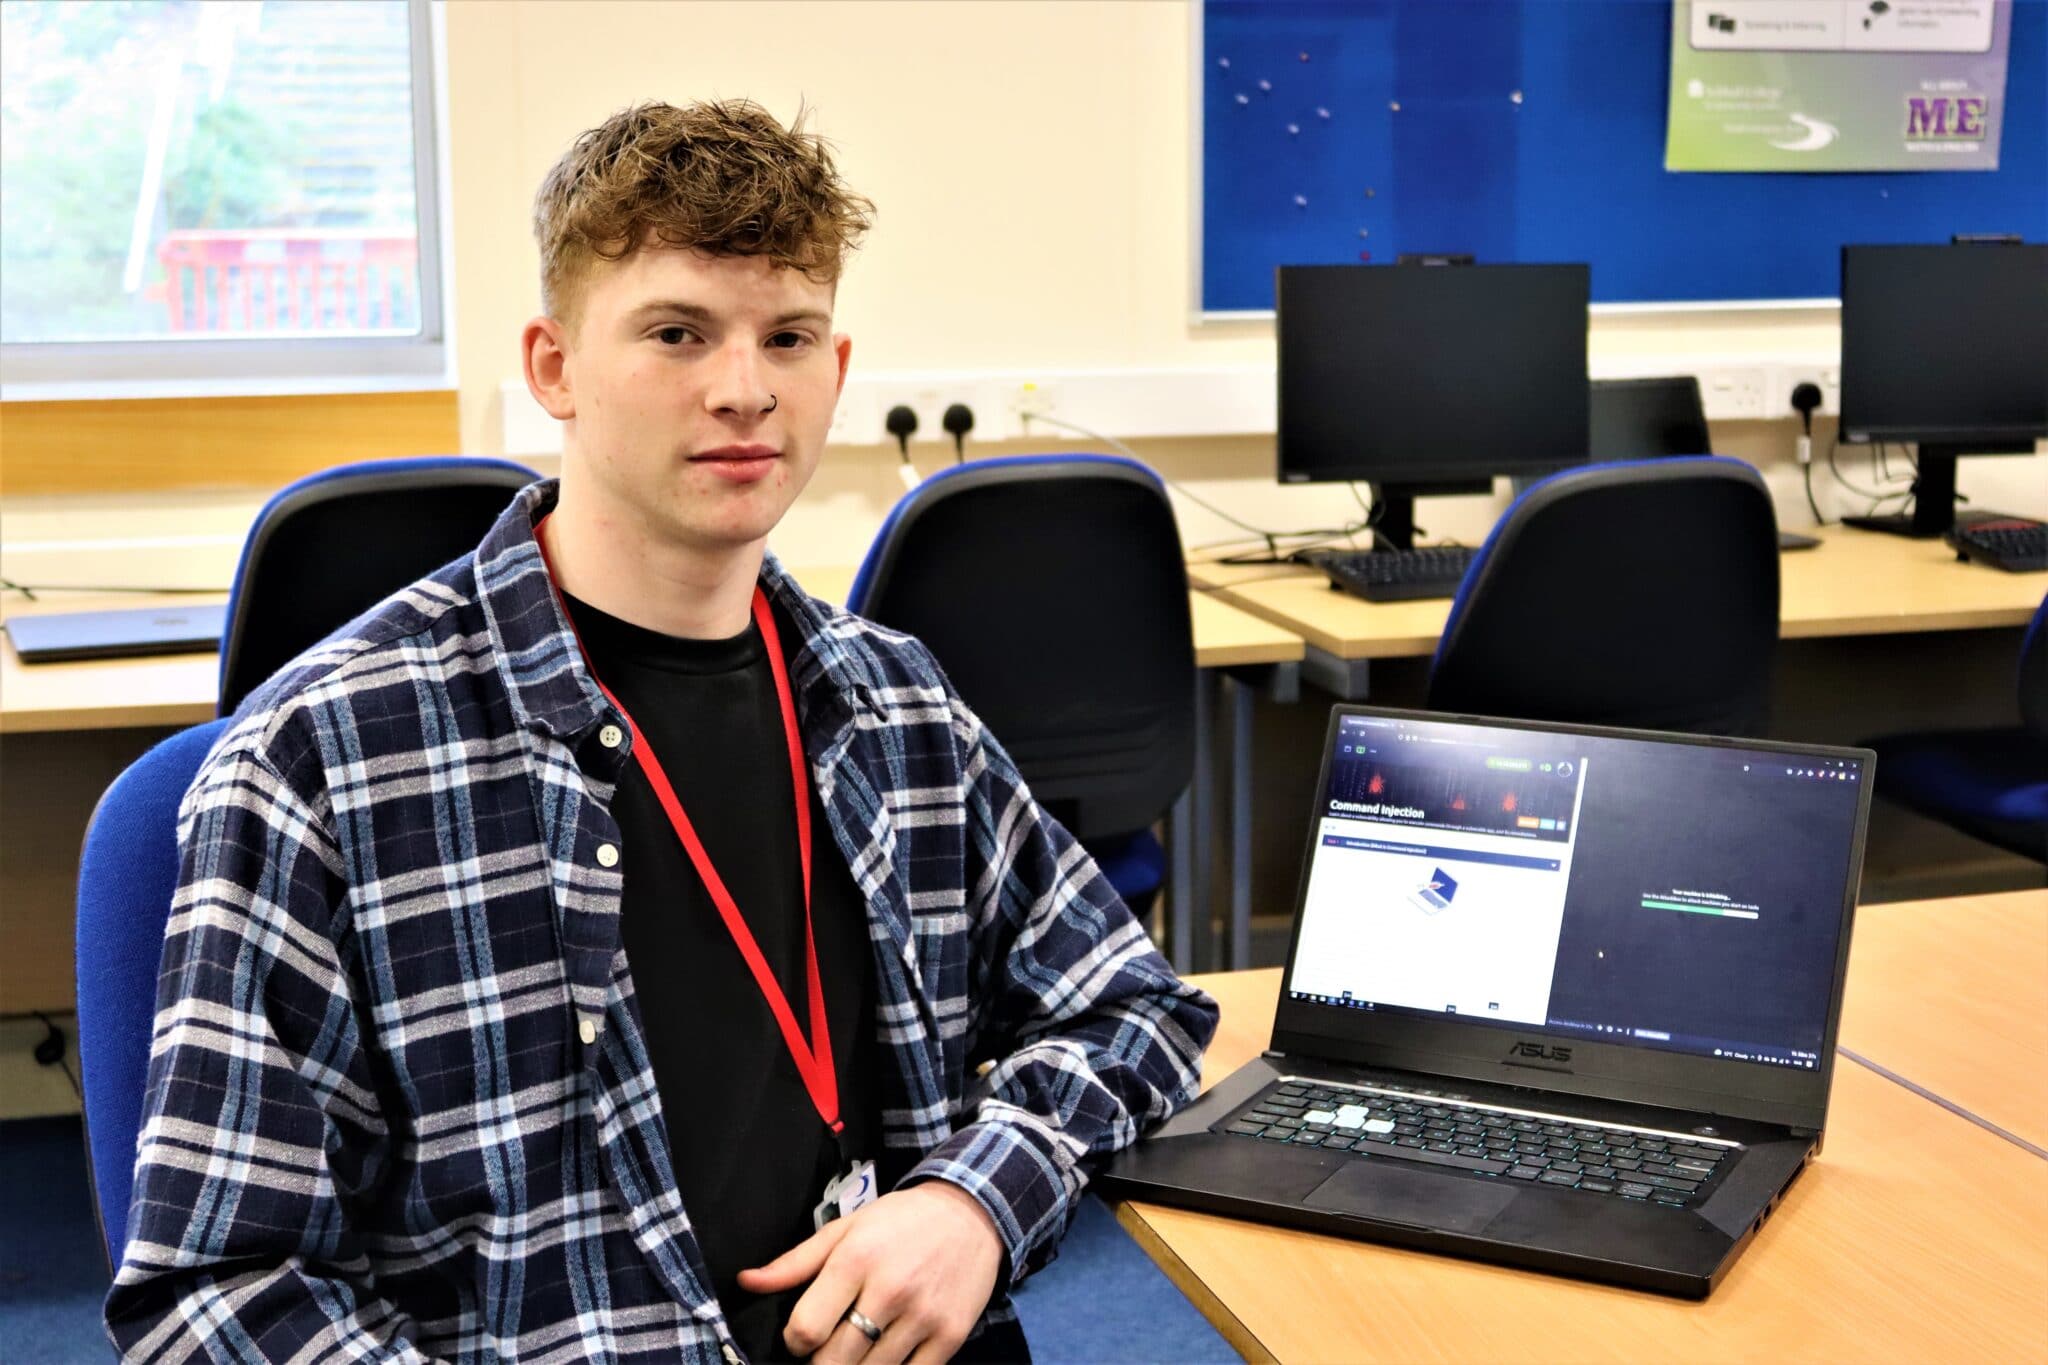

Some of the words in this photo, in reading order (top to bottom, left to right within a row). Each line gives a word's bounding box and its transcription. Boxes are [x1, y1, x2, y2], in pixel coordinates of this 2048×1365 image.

[1906, 97, 1984, 136] ME
[1330, 799, 1380, 814] Command
[1381, 804, 1424, 818] Injection
[1509, 1042, 1572, 1062] ASUS
